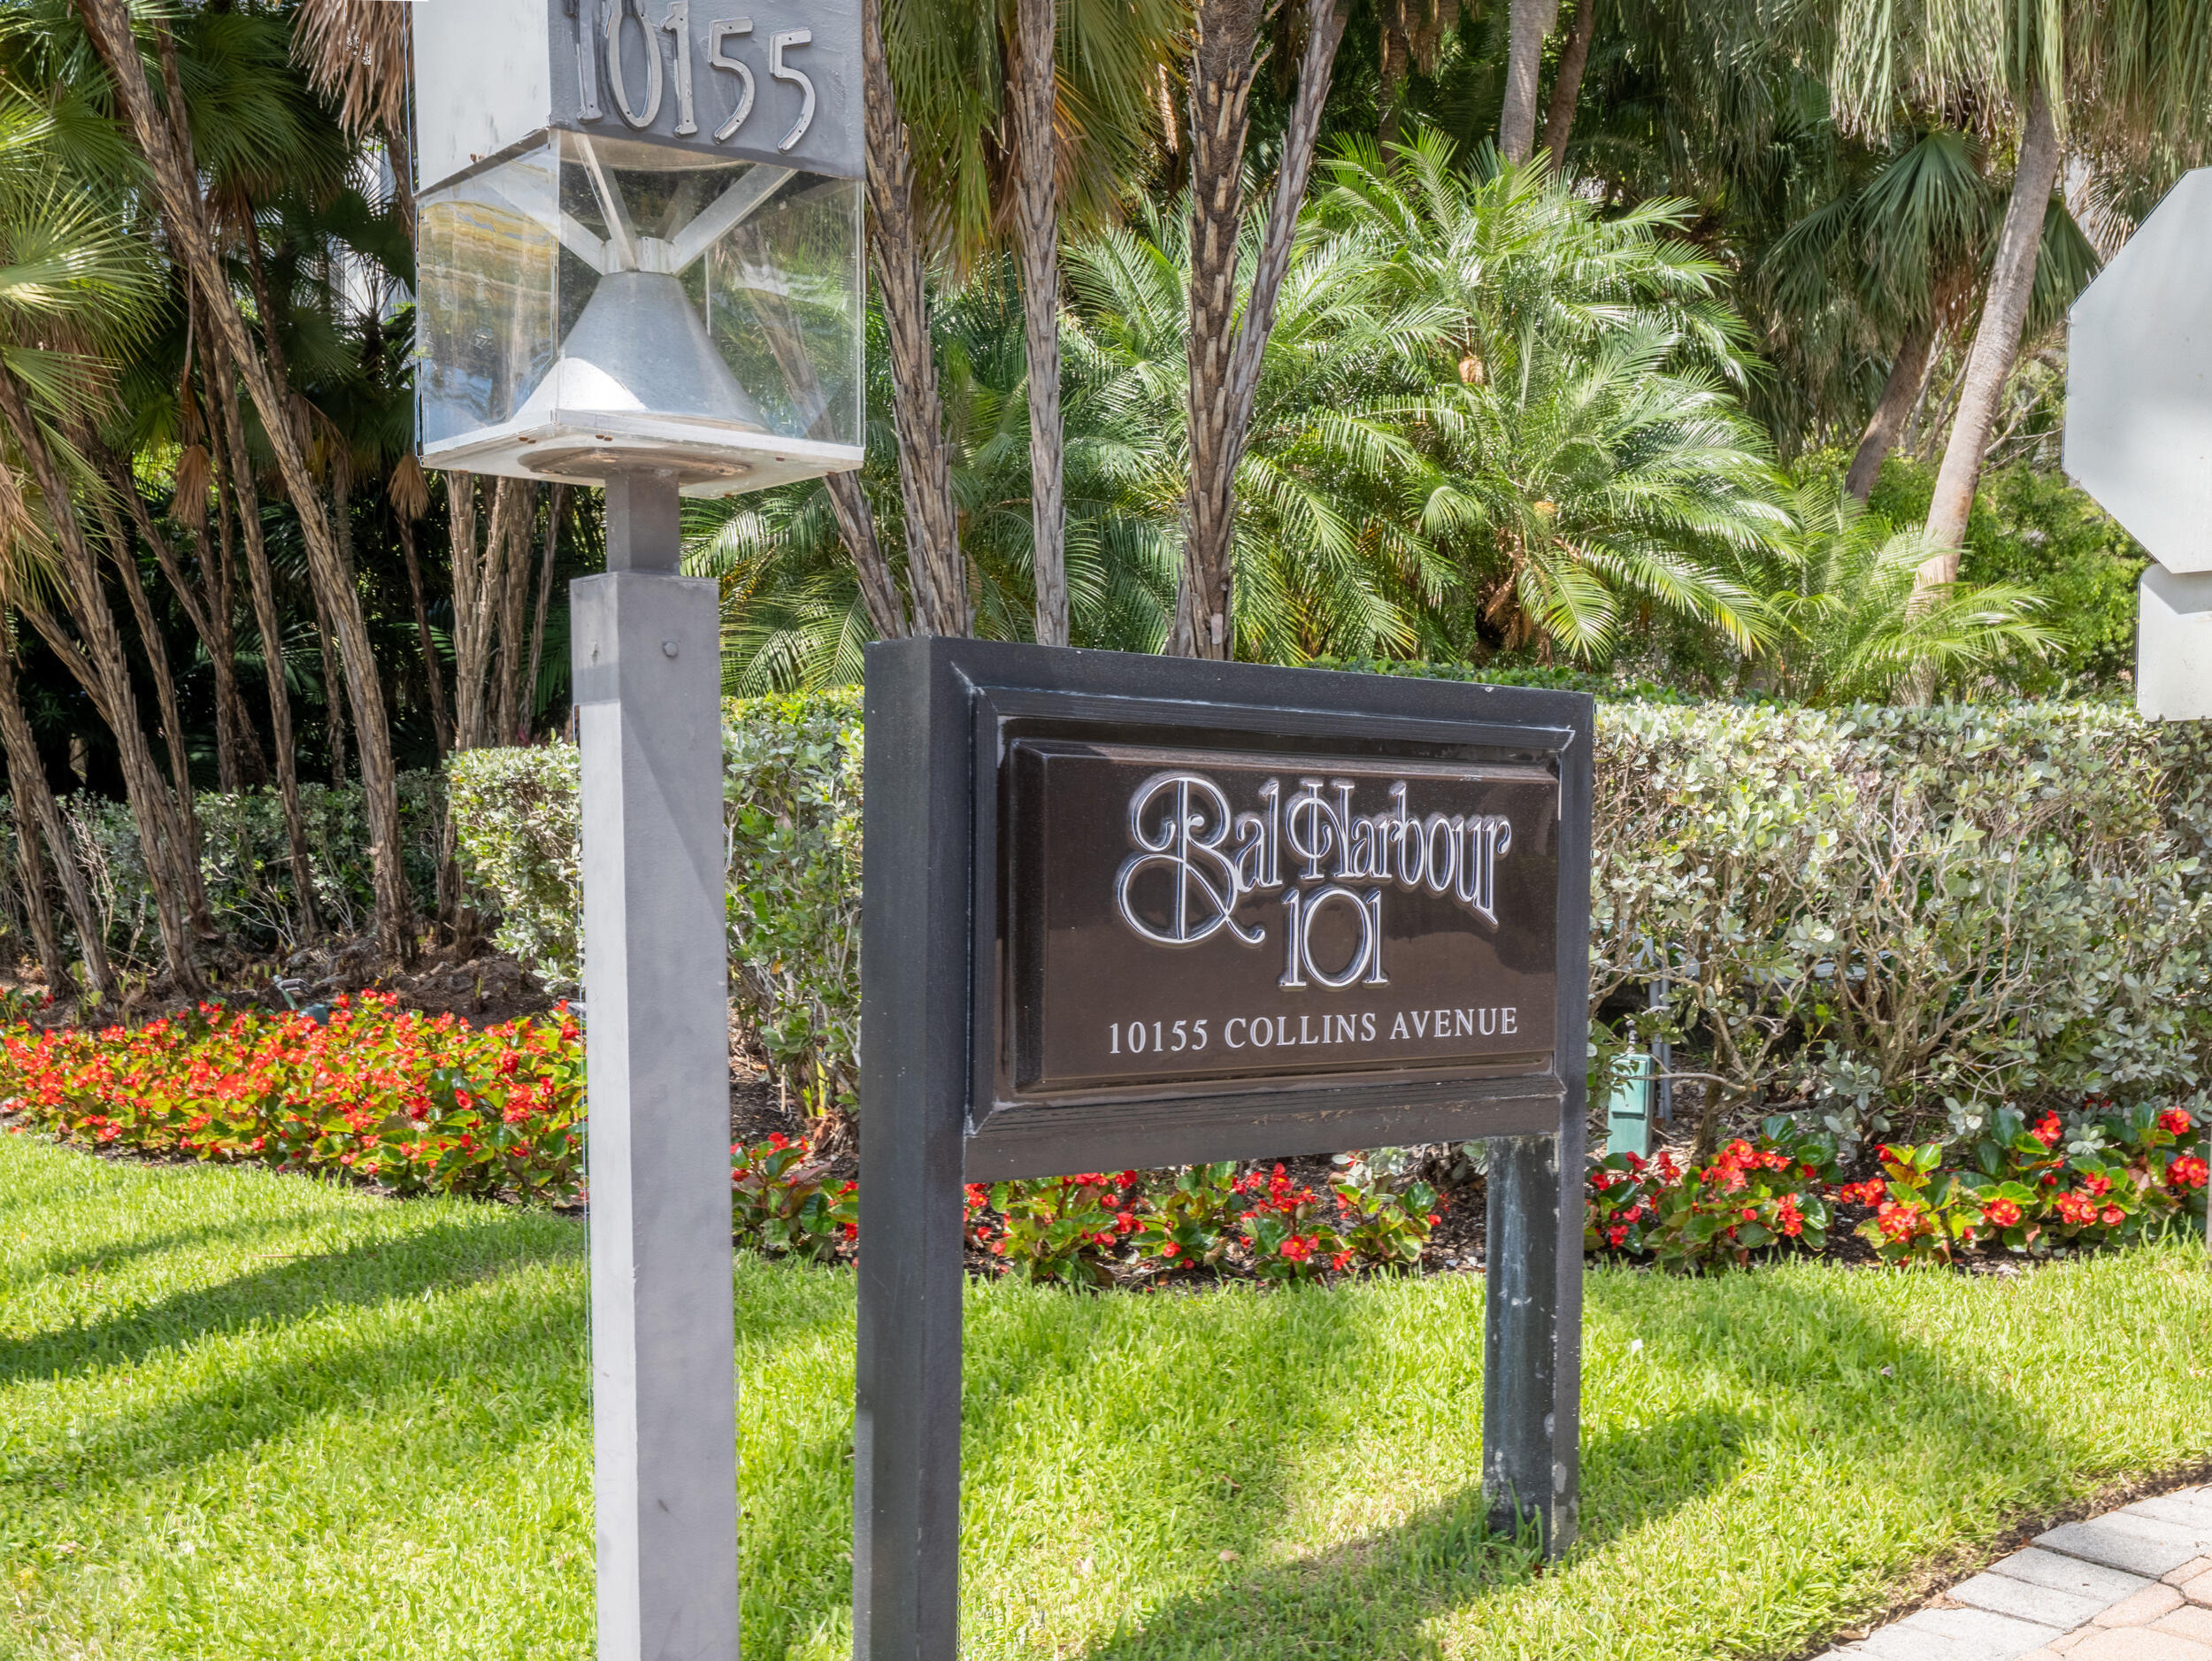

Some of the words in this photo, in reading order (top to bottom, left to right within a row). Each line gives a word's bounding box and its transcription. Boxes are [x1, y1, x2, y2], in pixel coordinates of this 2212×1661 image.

[563, 0, 817, 153] 10155
[1118, 775, 1283, 945] Bal
[1279, 888, 1389, 988] 101
[1109, 1019, 1209, 1055] 10155
[1224, 1012, 1378, 1049] COLLINS
[1389, 1006, 1519, 1041] AVENUE
